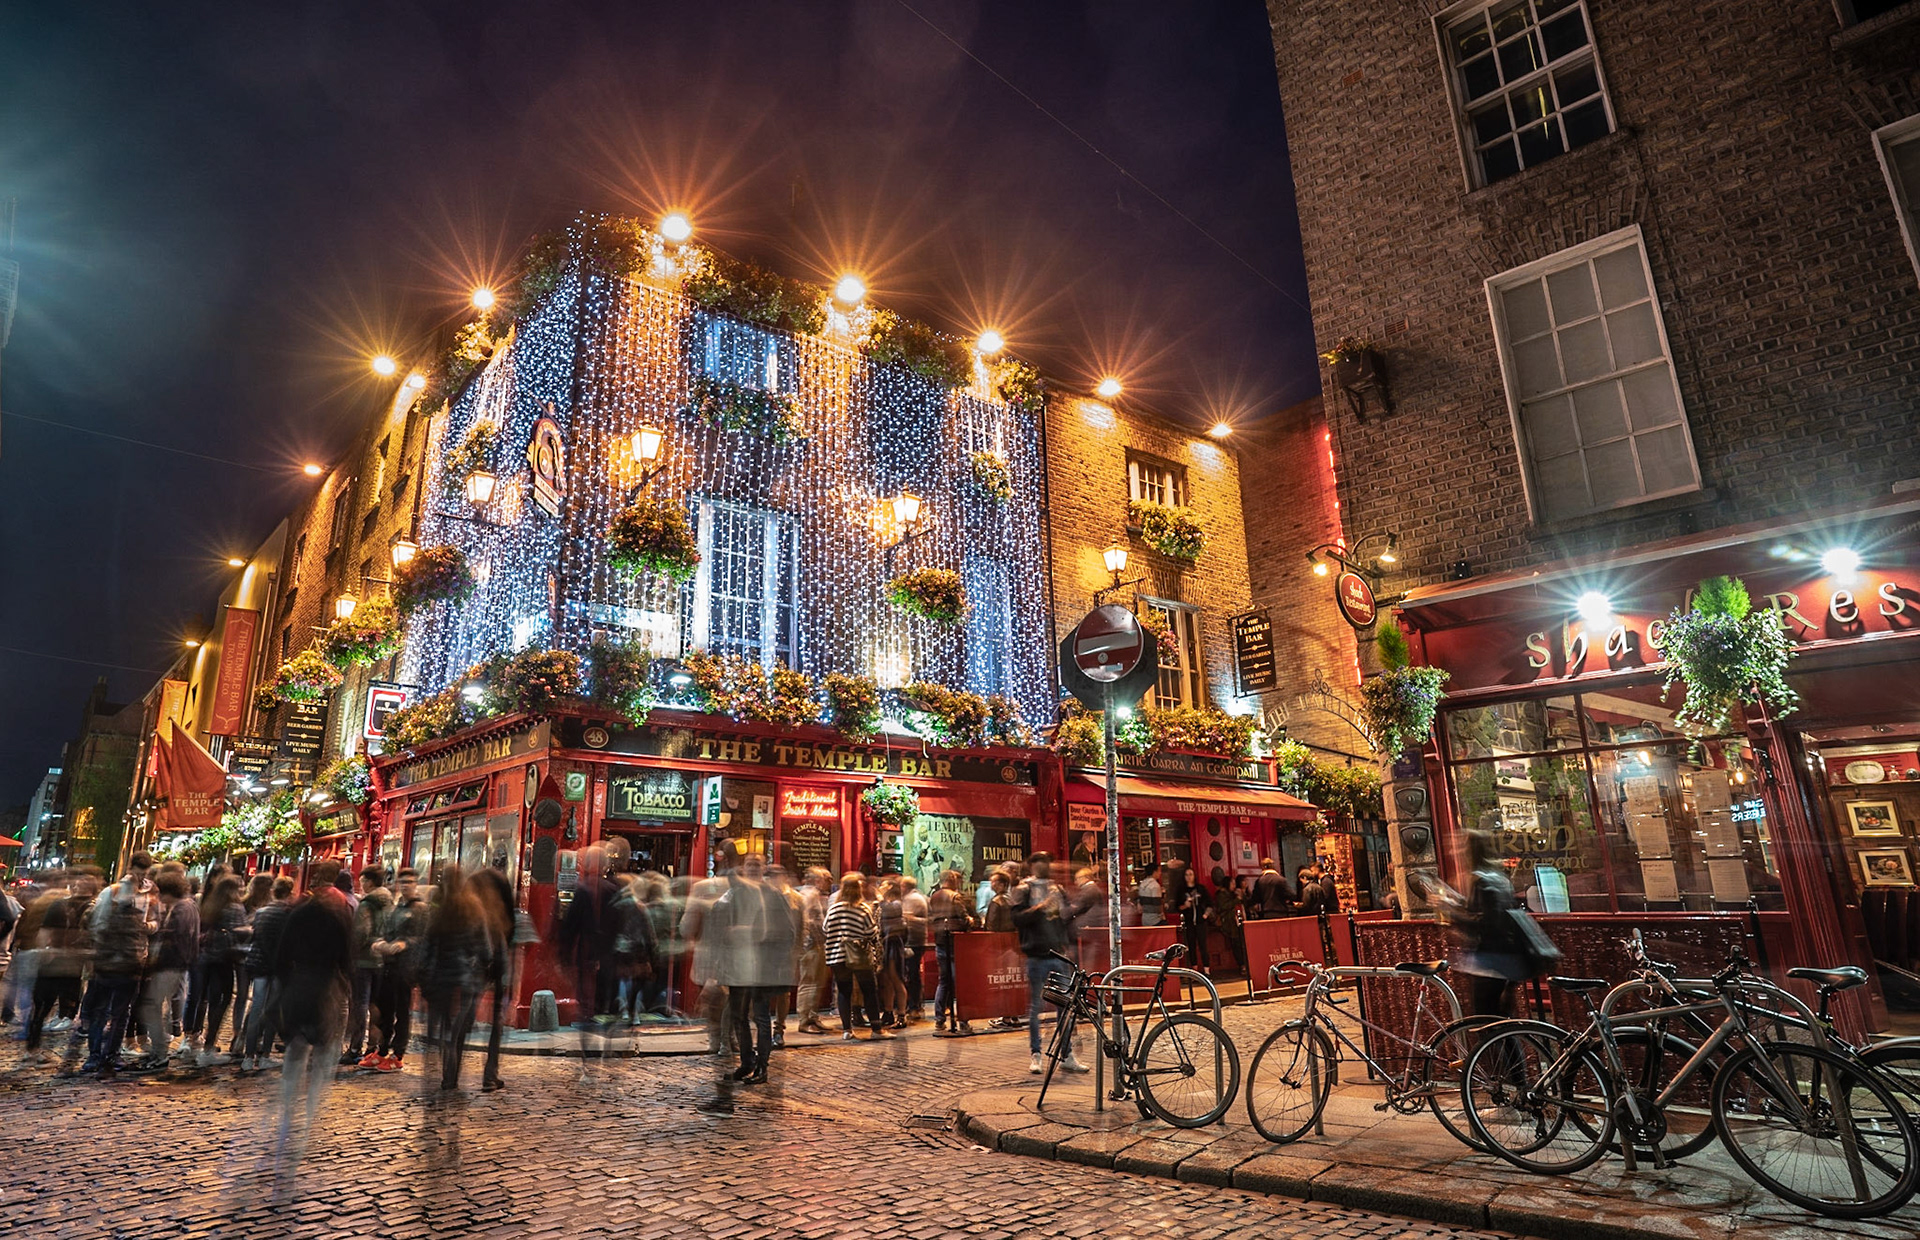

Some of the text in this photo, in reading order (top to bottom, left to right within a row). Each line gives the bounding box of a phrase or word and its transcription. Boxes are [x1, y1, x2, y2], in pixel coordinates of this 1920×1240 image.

[1237, 623, 1270, 635] TEMPLE
[1245, 633, 1263, 643] BAR
[223, 643, 236, 682] TRADING
[228, 630, 249, 712] THE TEMPLE BAR
[1249, 677, 1265, 685] DAILY
[297, 704, 318, 714] BAR
[588, 731, 603, 743] 48
[408, 763, 429, 783] THE
[432, 747, 478, 776] TEMPLE
[484, 737, 512, 761] BAR
[698, 738, 952, 779] THE TEMPLE BAR
[174, 798, 221, 807] TEMPLE
[785, 790, 837, 803] Traditional
[184, 807, 209, 815] BAR
[670, 808, 689, 816] Stock
[783, 803, 838, 817] Irish Music
[1177, 802, 1195, 812] THE
[1196, 803, 1229, 814] TEMPLE
[1230, 806, 1247, 815] BAR
[793, 823, 830, 836] TEMPLE BAR
[928, 820, 972, 833] TEMPLE
[940, 833, 962, 844] BAR
[1004, 832, 1022, 846] THE
[983, 847, 1022, 861] EMPEROR
[987, 974, 1022, 984] TEMPLE
